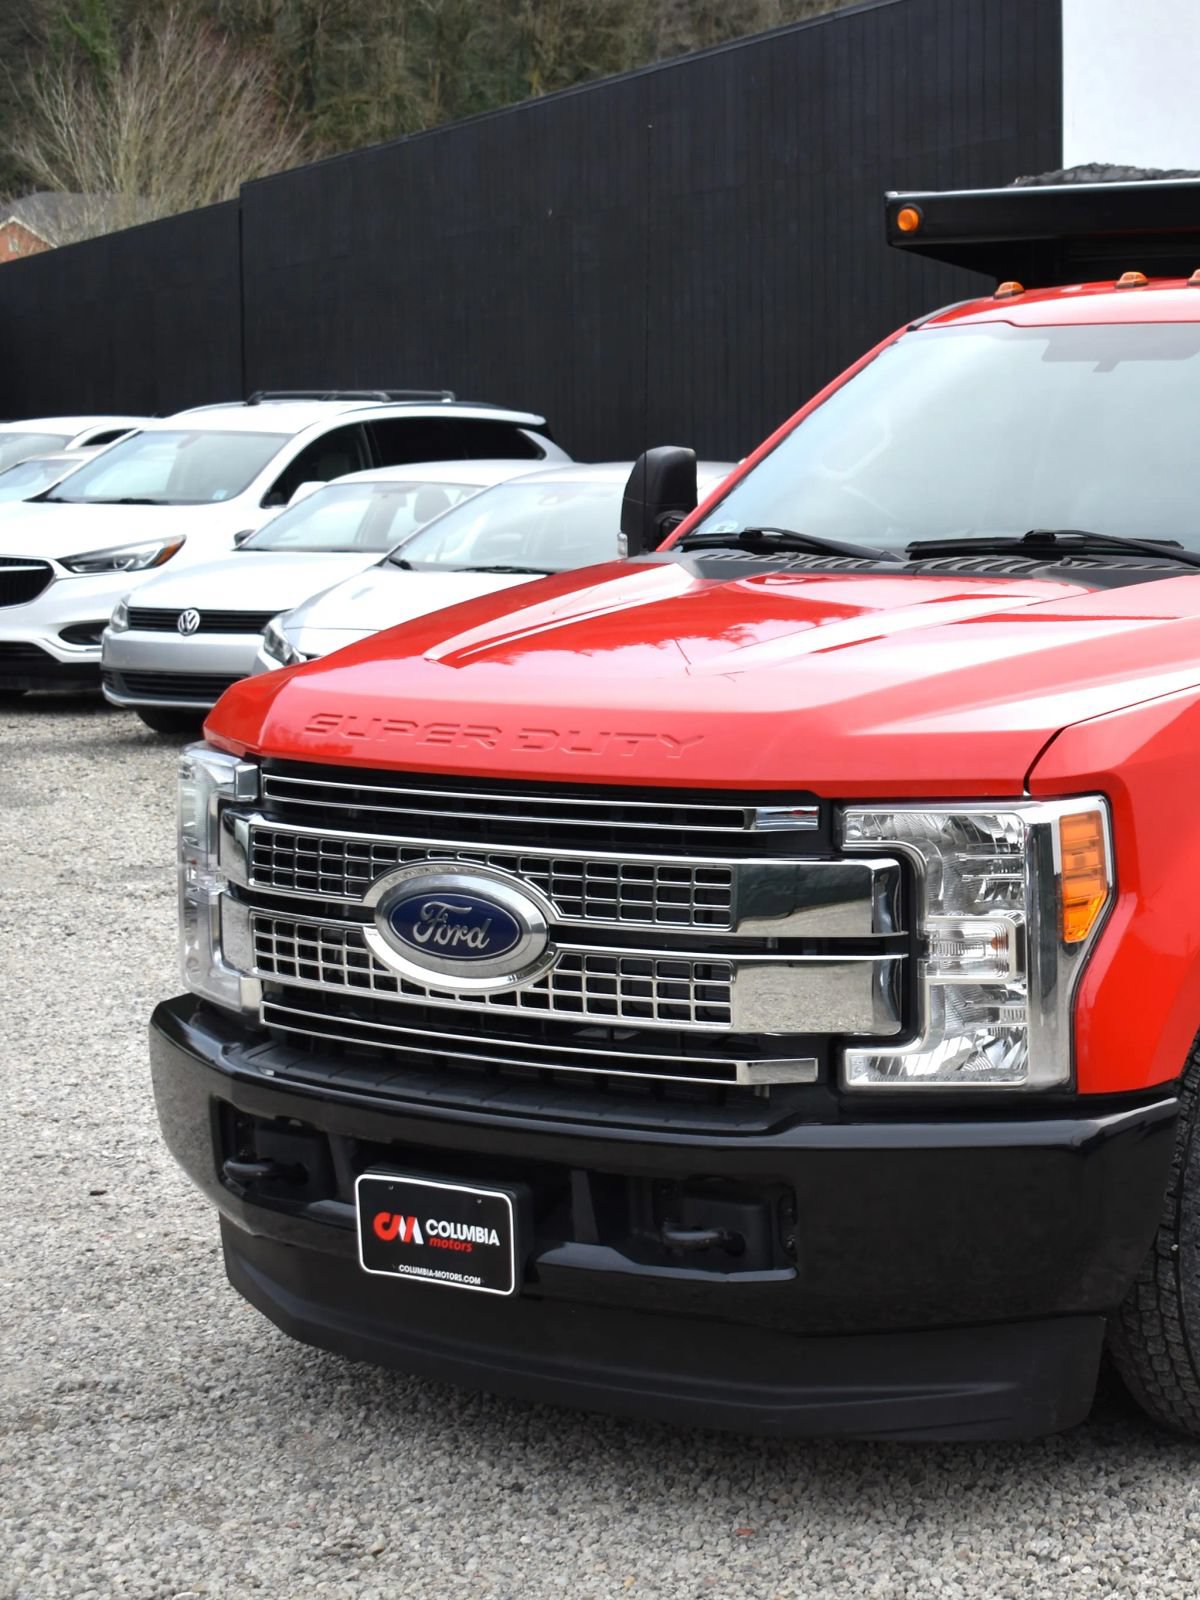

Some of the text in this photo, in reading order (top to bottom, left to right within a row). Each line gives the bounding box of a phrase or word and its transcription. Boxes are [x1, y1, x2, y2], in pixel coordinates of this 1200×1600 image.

[303, 713, 705, 758] SUPER DUTY
[412, 900, 493, 949] Ford
[425, 1219, 501, 1246] COLUMBIA
[429, 1236, 473, 1252] motors
[398, 1264, 481, 1285] COLUMBIA-MOTORS.COM
